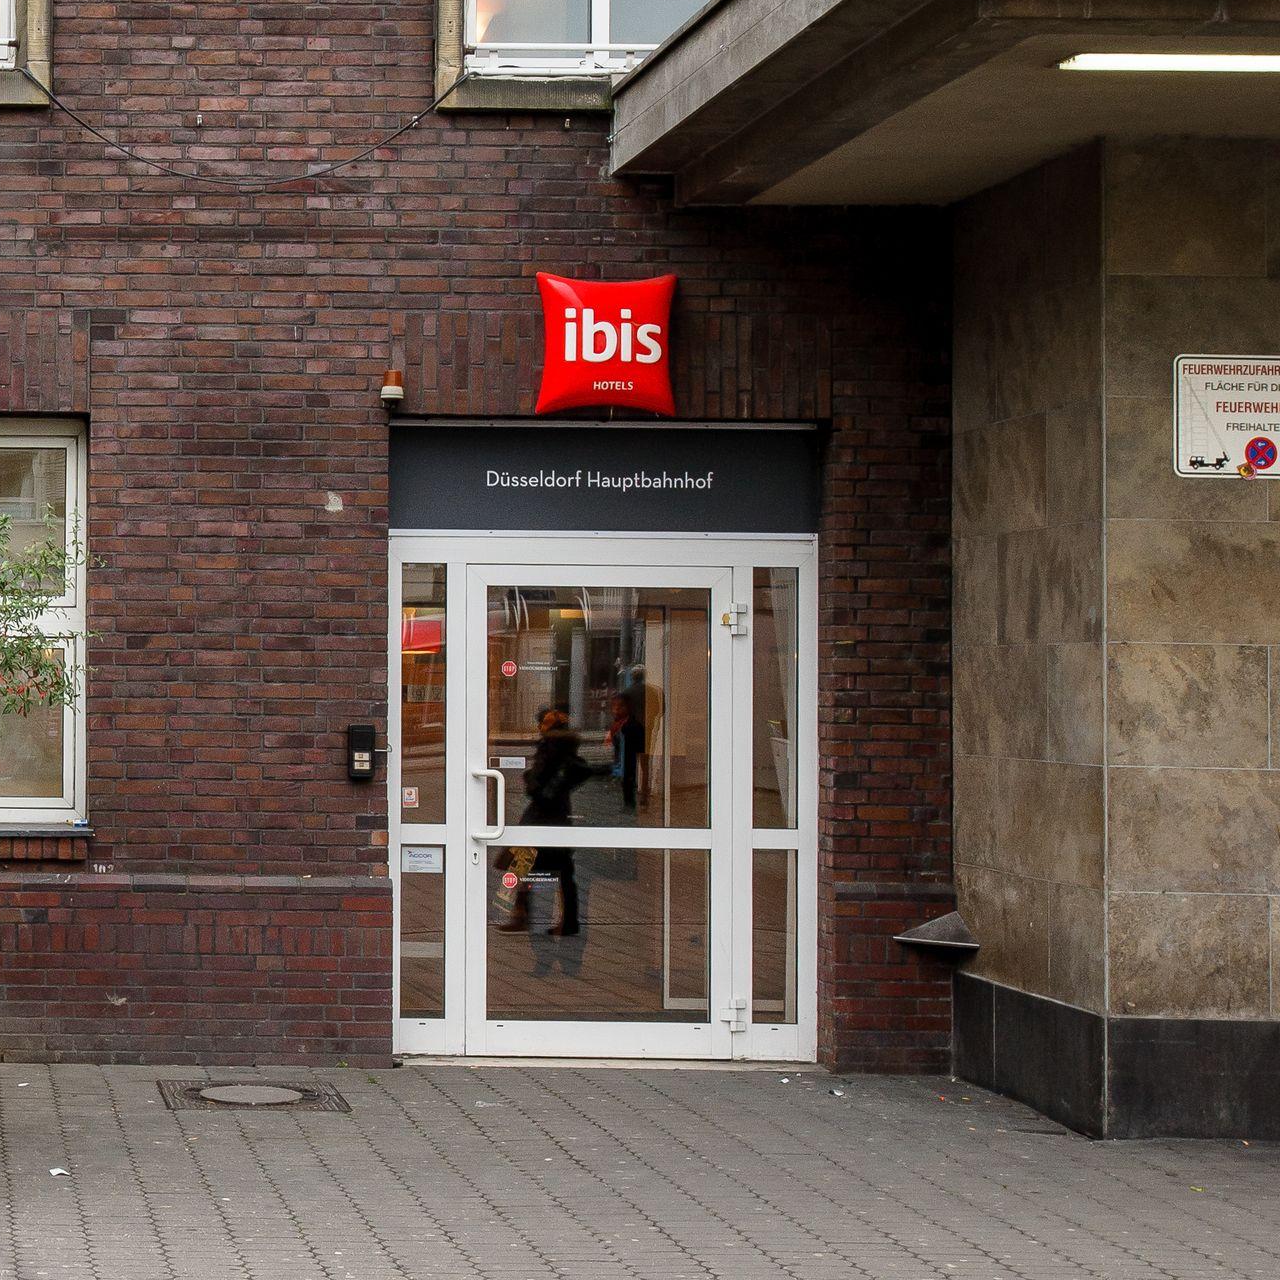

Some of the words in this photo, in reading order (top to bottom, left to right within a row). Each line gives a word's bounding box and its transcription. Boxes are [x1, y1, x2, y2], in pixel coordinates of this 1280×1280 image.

[564, 307, 662, 364] ibis
[592, 380, 634, 392] HOTELS
[1204, 381, 1245, 391] FLÄCHE
[1247, 381, 1269, 391] FÜR
[1215, 401, 1280, 413] FEUERWEH
[486, 469, 582, 488] Düsseldorf
[587, 470, 713, 492] Hauptbahnhof
